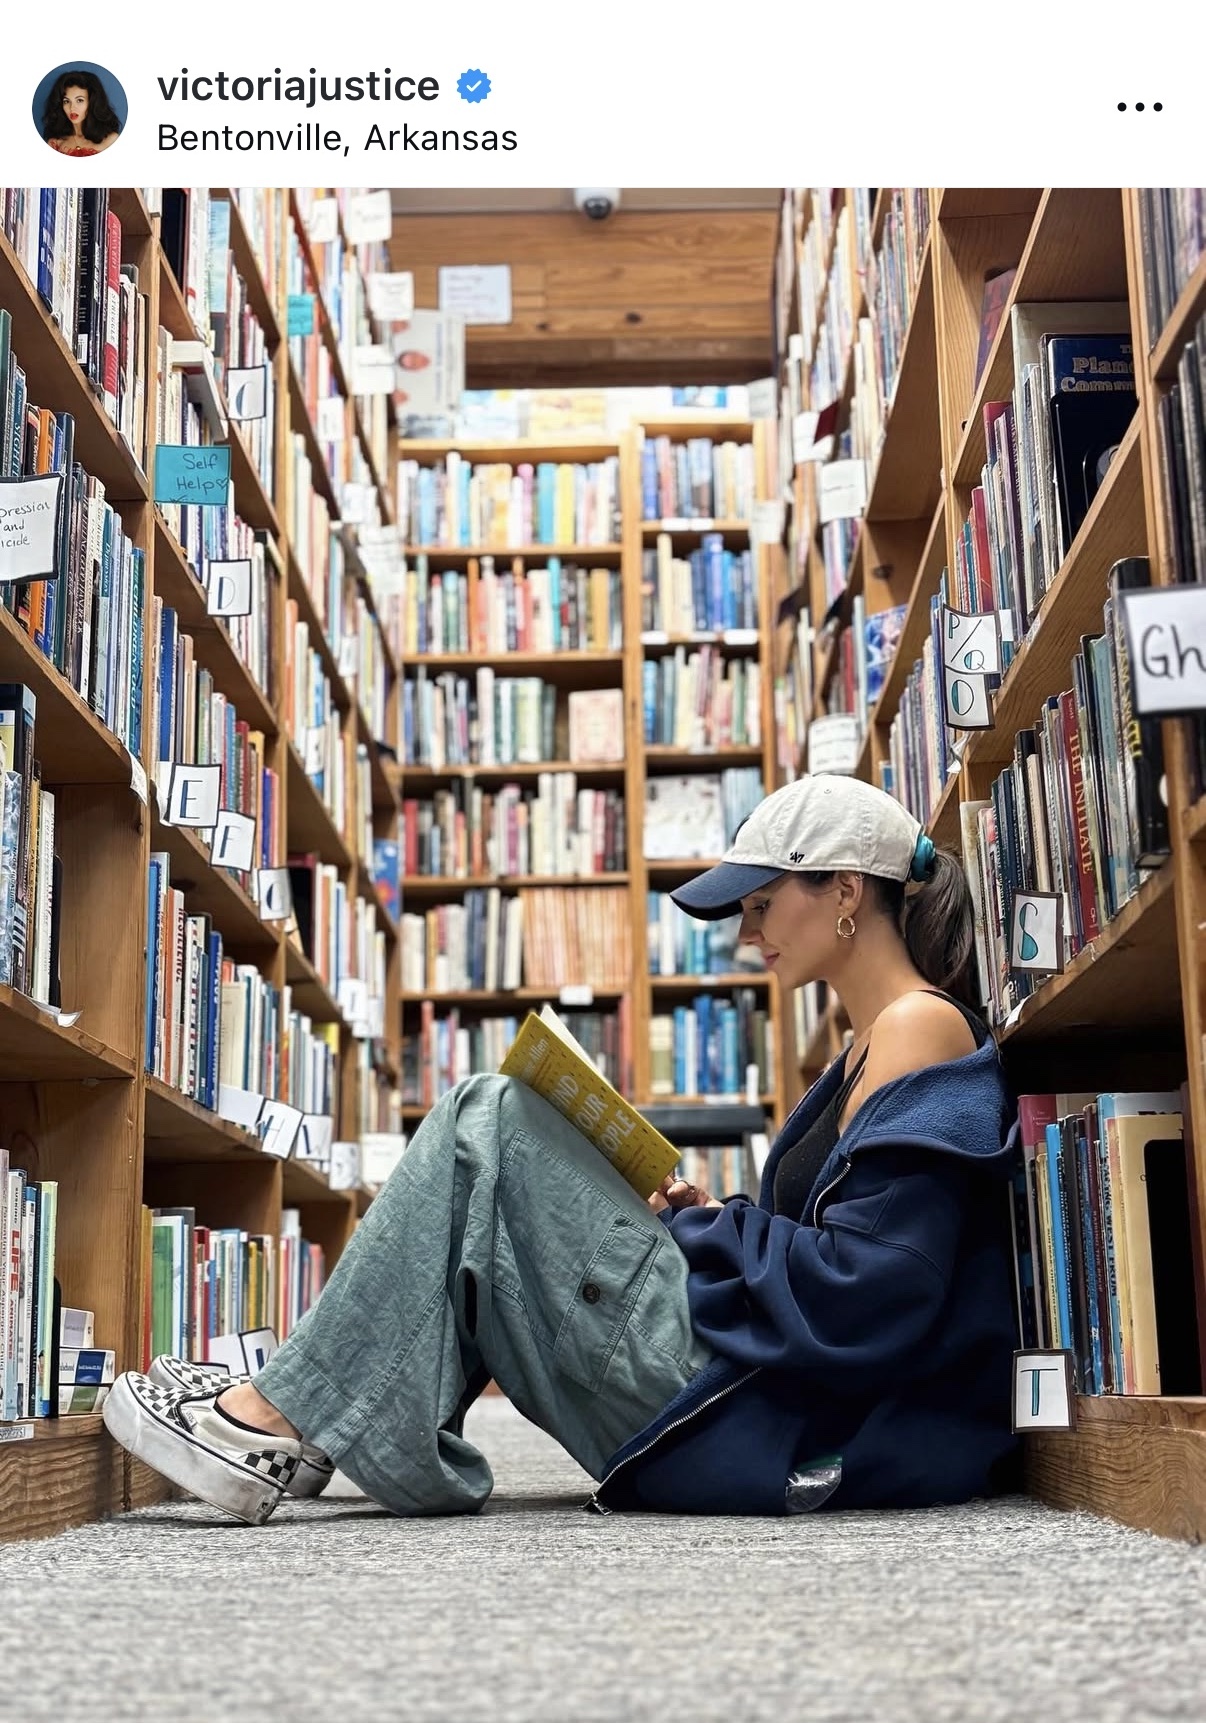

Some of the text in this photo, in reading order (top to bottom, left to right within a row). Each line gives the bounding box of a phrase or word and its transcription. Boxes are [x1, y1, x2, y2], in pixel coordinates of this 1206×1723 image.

[182, 453, 218, 470] Self
[176, 475, 215, 495] Help
[3, 519, 25, 532] and
[217, 576, 235, 610] D
[1068, 730, 1083, 776] THE
[180, 779, 203, 820] E
[219, 825, 242, 859] F
[1074, 783, 1093, 875] INITIATE
[1018, 902, 1040, 961] S
[529, 1038, 549, 1061] Allen
[575, 1093, 608, 1131] OUR
[264, 1114, 286, 1149] H
[600, 1110, 637, 1153] OPLE
[1020, 1367, 1059, 1417] T
